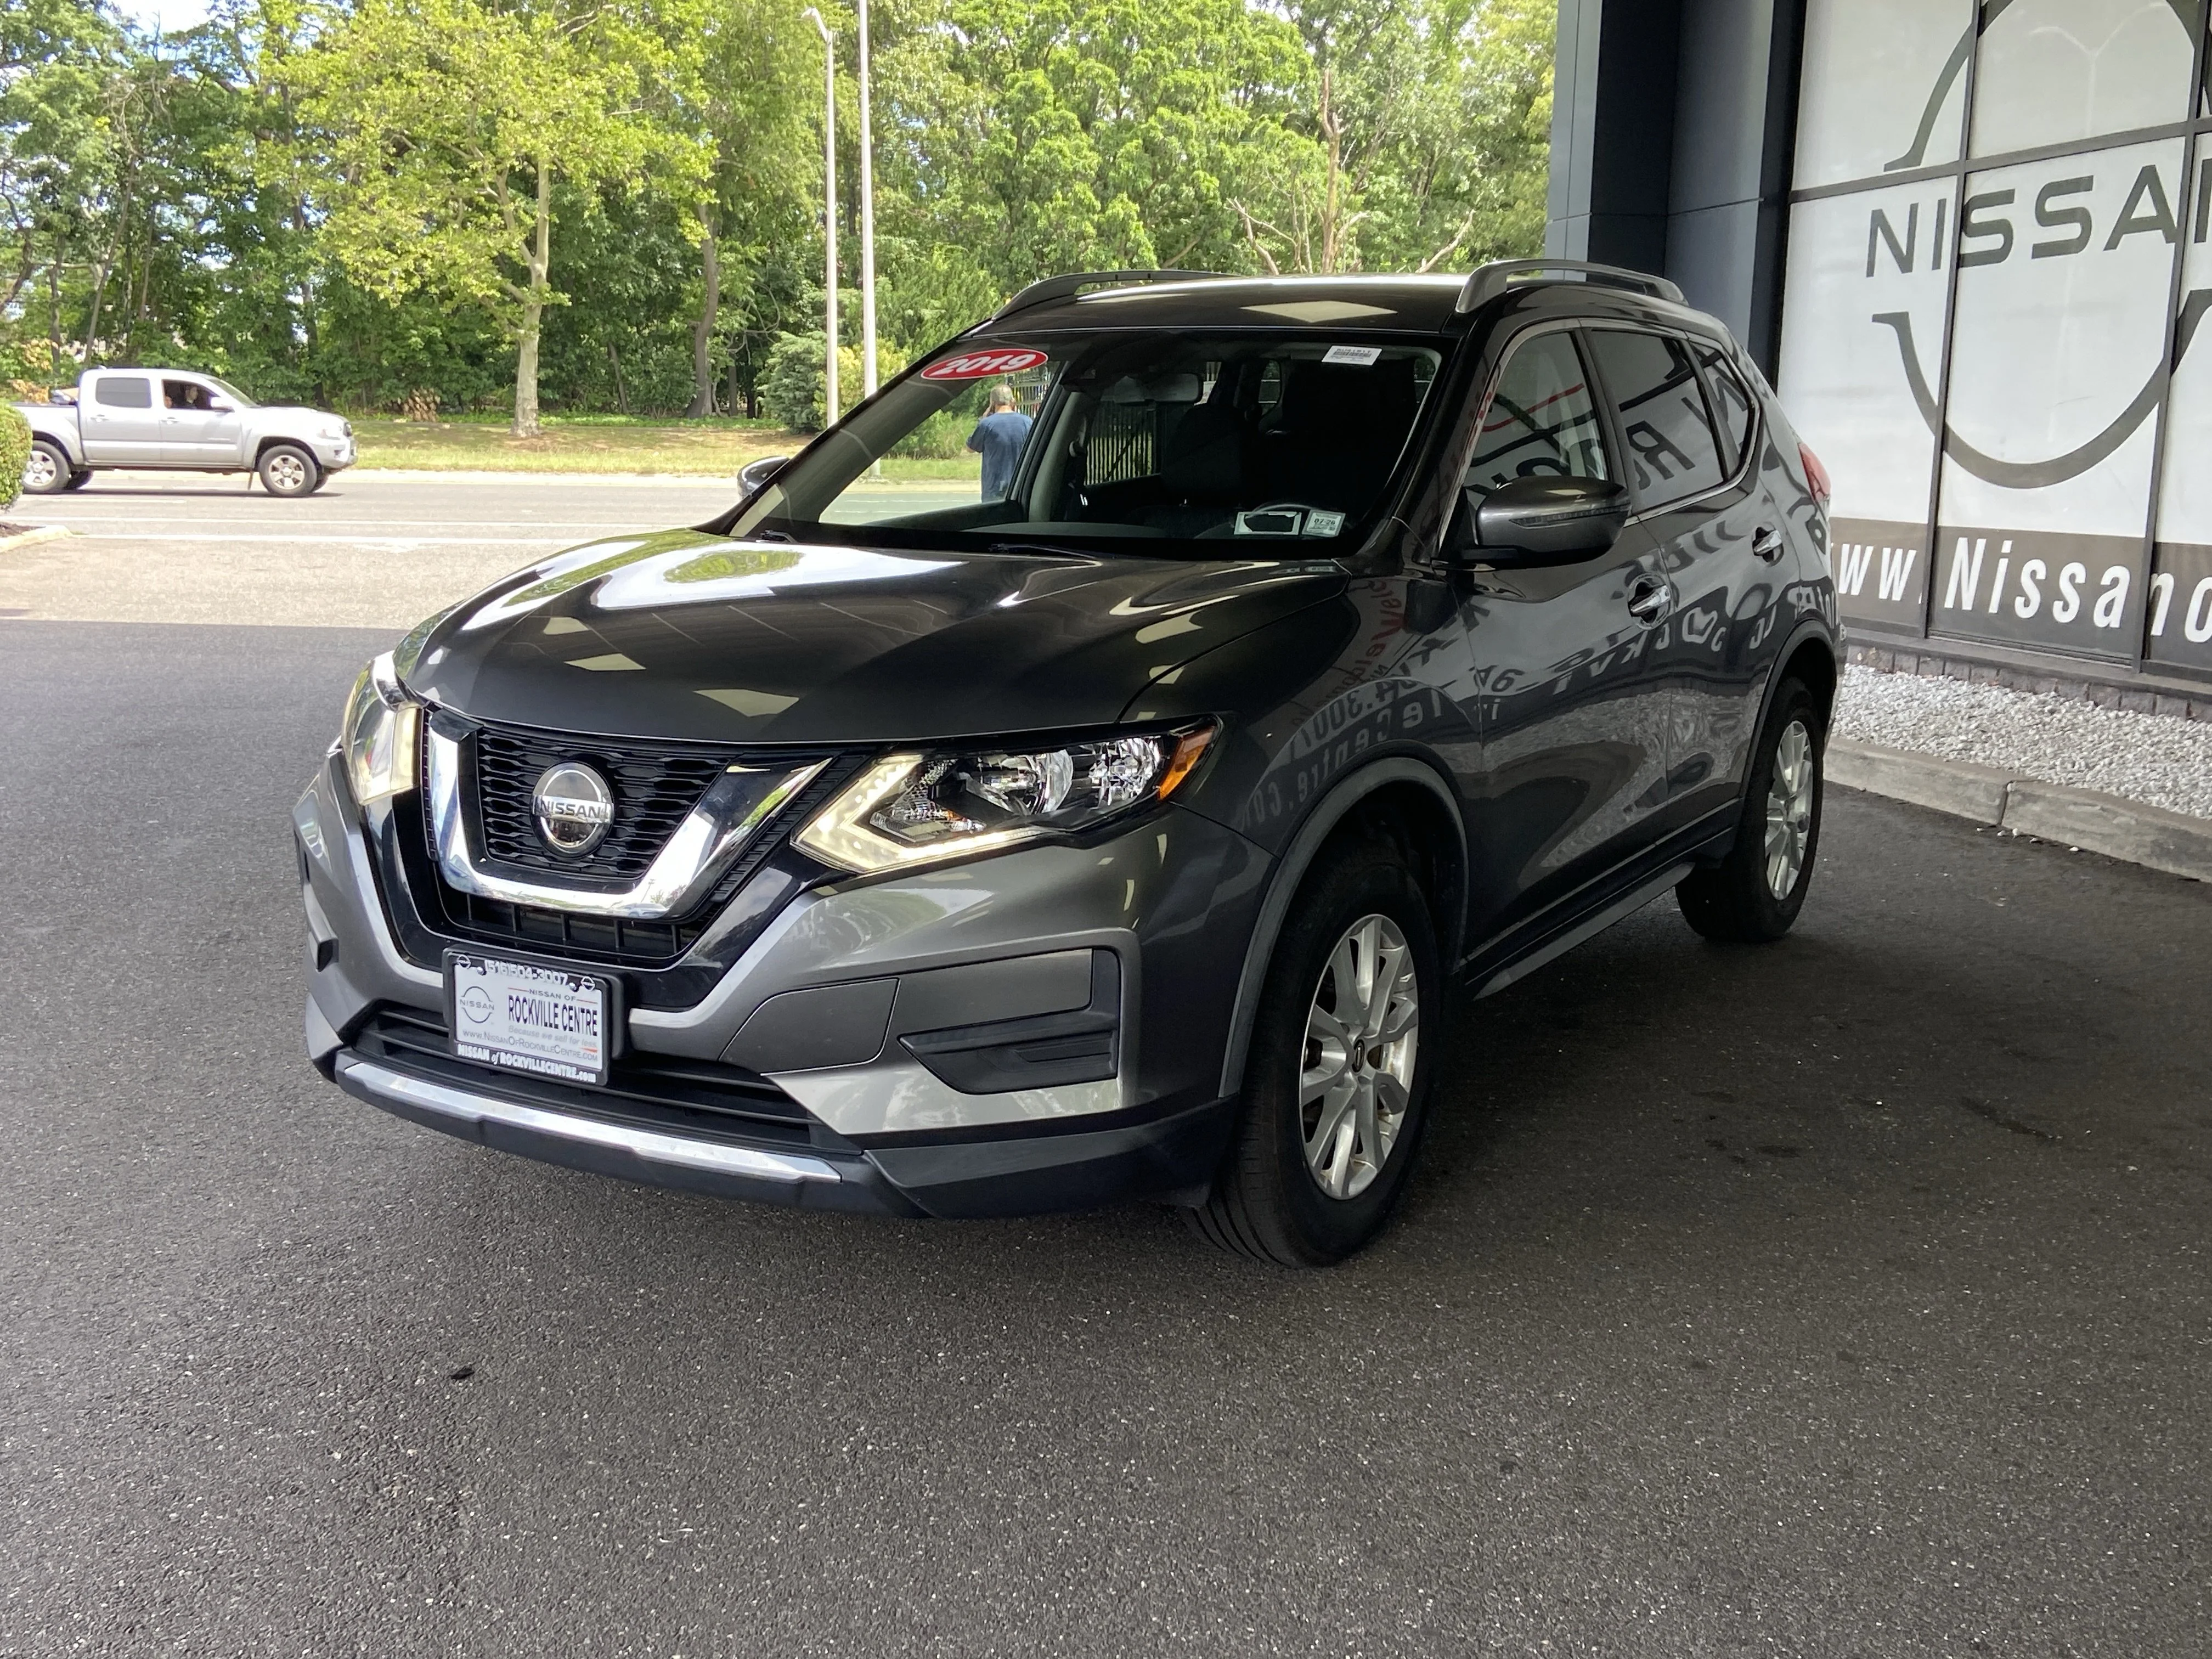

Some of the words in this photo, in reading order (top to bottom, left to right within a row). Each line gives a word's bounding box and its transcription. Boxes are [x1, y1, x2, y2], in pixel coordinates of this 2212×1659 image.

[1866, 158, 2212, 278] NISSA
[929, 354, 1036, 376] 2019
[540, 799, 601, 819] NISSAN
[460, 998, 494, 1011] NISSAN
[529, 989, 561, 1000] NISSAN
[508, 995, 559, 1029] ROCKVILLE
[562, 1004, 597, 1037] CENTRE
[508, 1025, 540, 1038] Because
[554, 1032, 567, 1042] sell
[569, 1035, 580, 1045] for
[458, 1043, 490, 1061] NISSAN
[490, 1052, 500, 1065] of
